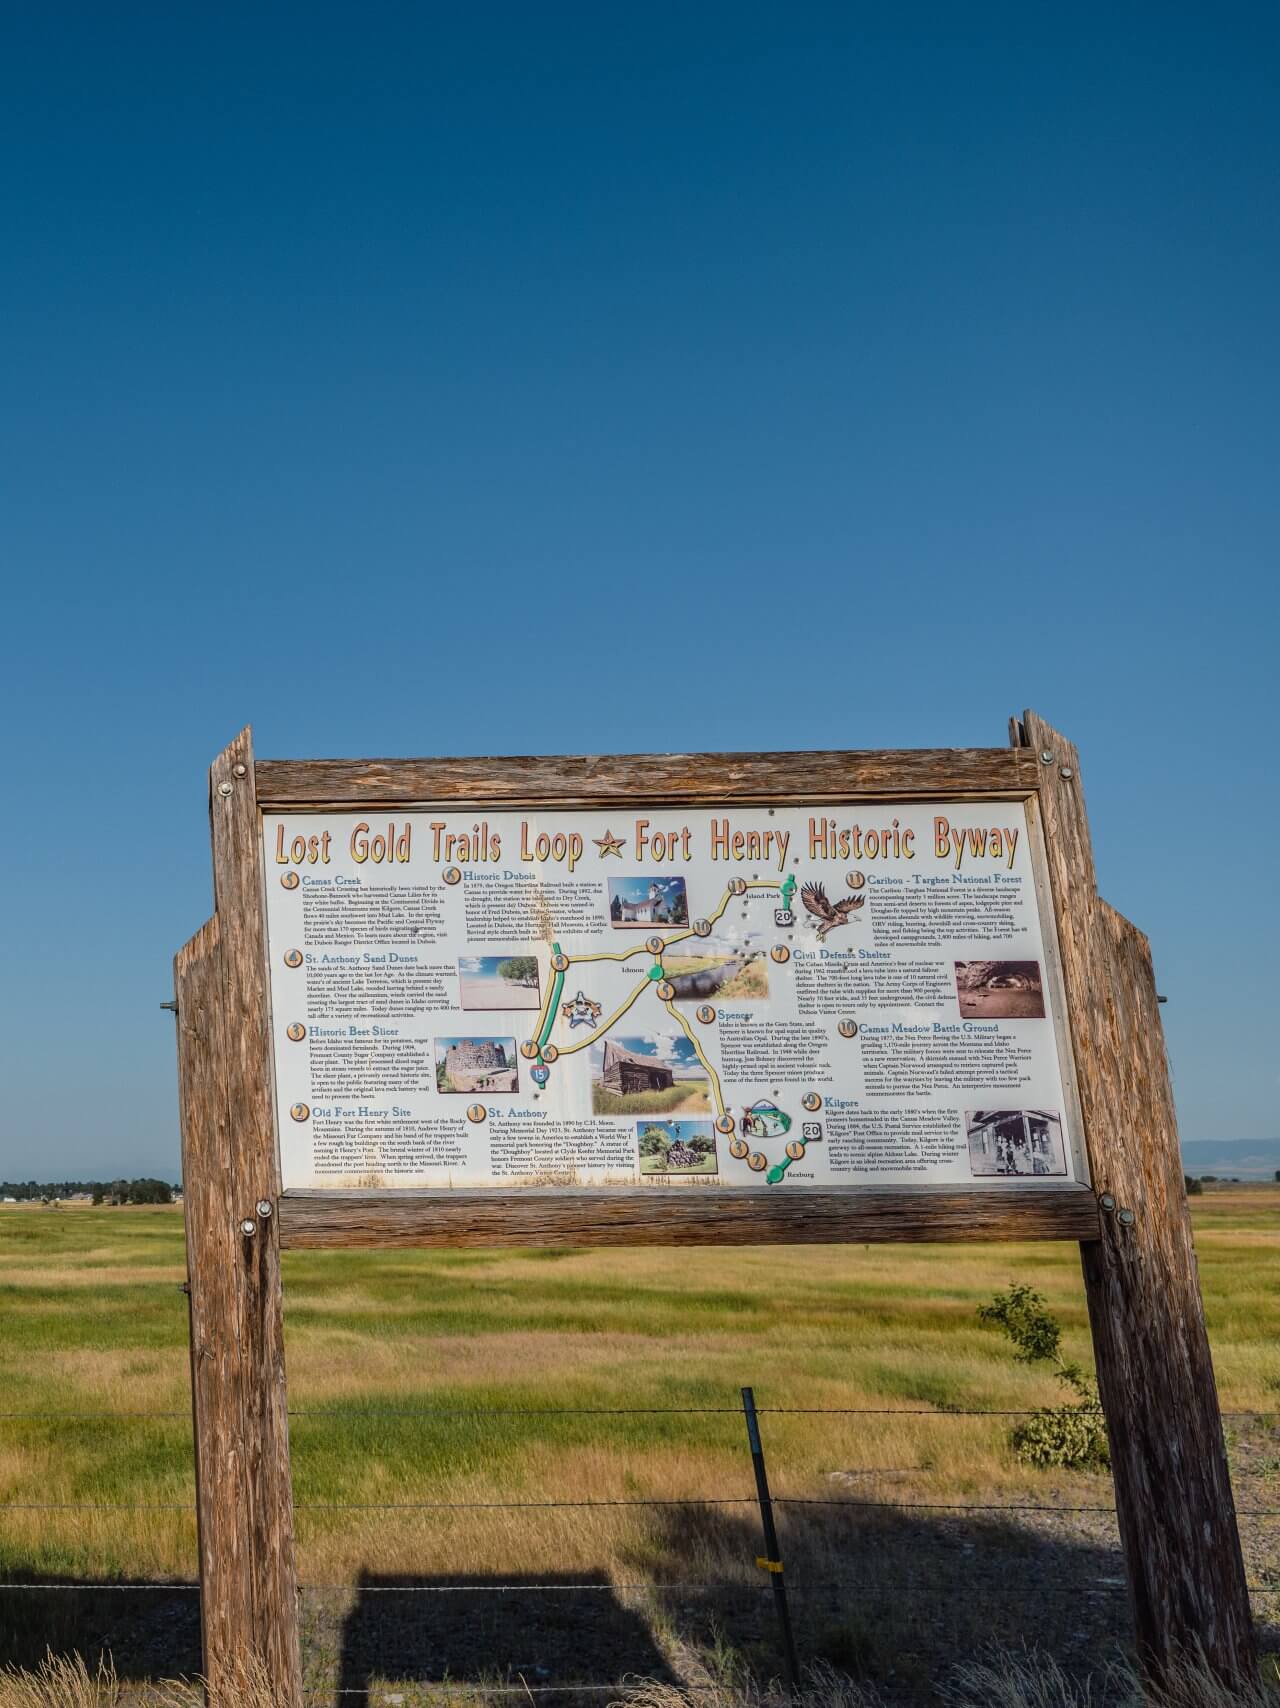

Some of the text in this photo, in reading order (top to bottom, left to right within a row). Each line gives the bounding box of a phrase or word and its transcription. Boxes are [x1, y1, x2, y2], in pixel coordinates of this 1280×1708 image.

[275, 816, 1019, 872] Lost Gold Trails Loop Fort Henry Historic Byway
[301, 875, 362, 886] Camas Creek
[463, 870, 537, 882] Historic Dubois
[866, 874, 904, 886] Caribou
[911, 874, 951, 886] Targhee
[952, 873, 993, 884] National
[993, 873, 1023, 884] Forest
[776, 912, 791, 921] 20
[305, 952, 418, 965] St. Anthony Sand Dunes
[792, 949, 891, 960] Civil Defense Shelter
[717, 1009, 754, 1021] Spencer
[308, 1025, 399, 1037] Historic Beet Slicer
[858, 1022, 1000, 1034] Camas Meadow Battle Ground
[534, 1069, 544, 1080] 15
[823, 1096, 859, 1108] Kilgore
[311, 1106, 412, 1119] Old Fort Henry Site
[488, 1107, 548, 1119] St. Anthony
[804, 1125, 819, 1135] 20
[786, 1171, 815, 1179] Rexburg
